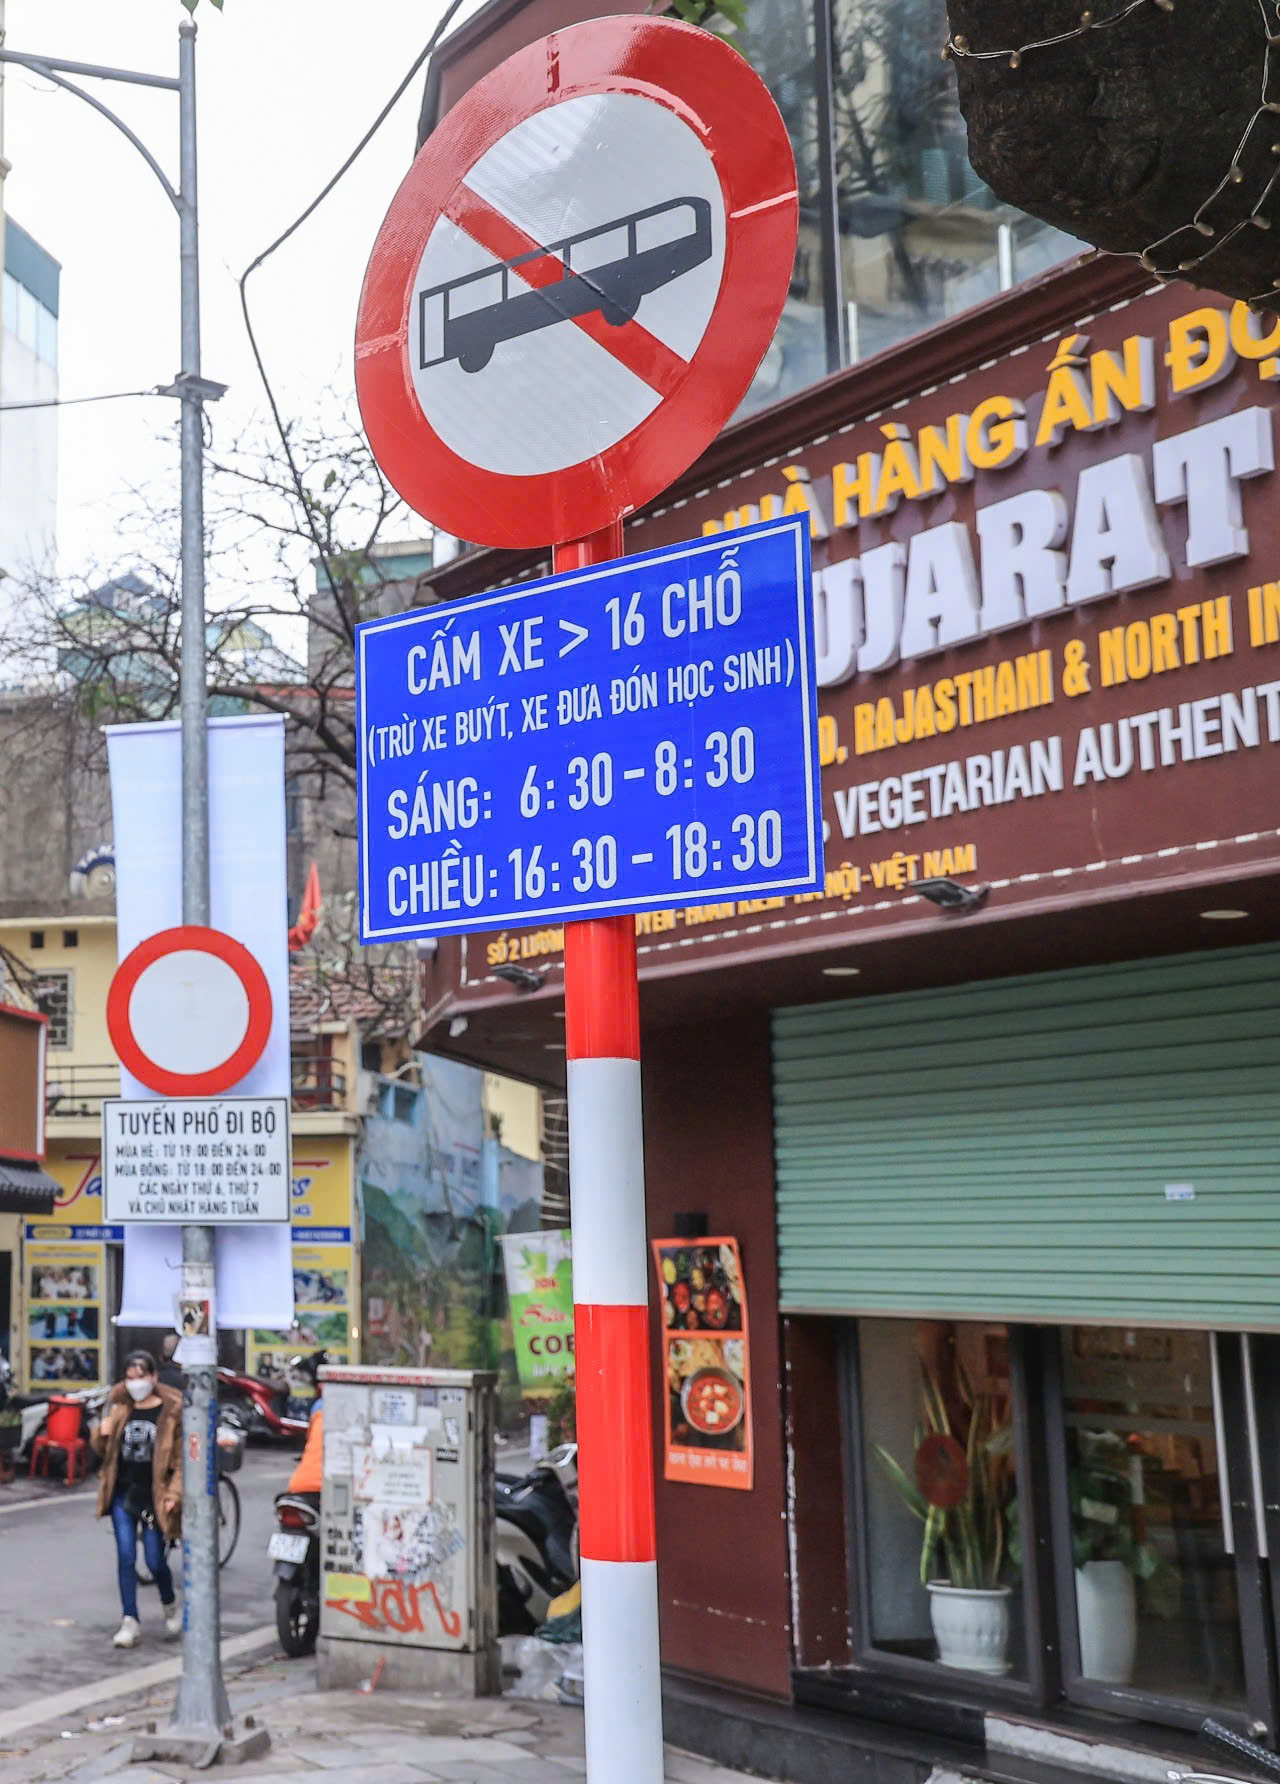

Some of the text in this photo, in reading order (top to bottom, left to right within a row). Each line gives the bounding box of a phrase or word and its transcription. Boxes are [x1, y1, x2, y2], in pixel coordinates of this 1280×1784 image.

[832, 394, 1028, 530] HÀNG
[1034, 333, 1154, 448] ẤN
[406, 545, 743, 696] CẤM XE > 16 CHỖ
[367, 637, 797, 768] (TRỪ XE BUÝT, XE ĐƯA ĐÓN HỌC SINH)
[854, 648, 1055, 756] RAJASTHANI
[1061, 637, 1093, 699] &
[1098, 595, 1234, 689] NORTH
[833, 680, 1280, 840] VEGETARIAN AUTHENT
[386, 769, 494, 841] SÁNG:
[386, 838, 499, 918] CHIỀU:
[923, 842, 978, 879] NAM
[115, 1141, 138, 1158] MÙA
[211, 1138, 233, 1158] ĐẾN
[118, 1103, 276, 1138] TUYẾN PHỐ ĐI BỘ
[114, 1160, 138, 1177] MÙA
[226, 1157, 248, 1177] ĐẾN
[138, 1178, 159, 1196] CÁC
[161, 1178, 188, 1196] NGÀY
[192, 1178, 213, 1196] THỨ
[228, 1178, 249, 1196] THỨ
[253, 1181, 260, 1196] 7
[128, 1198, 260, 1216] VÀ CHỦ NHẬT HÀNG TUẦN
